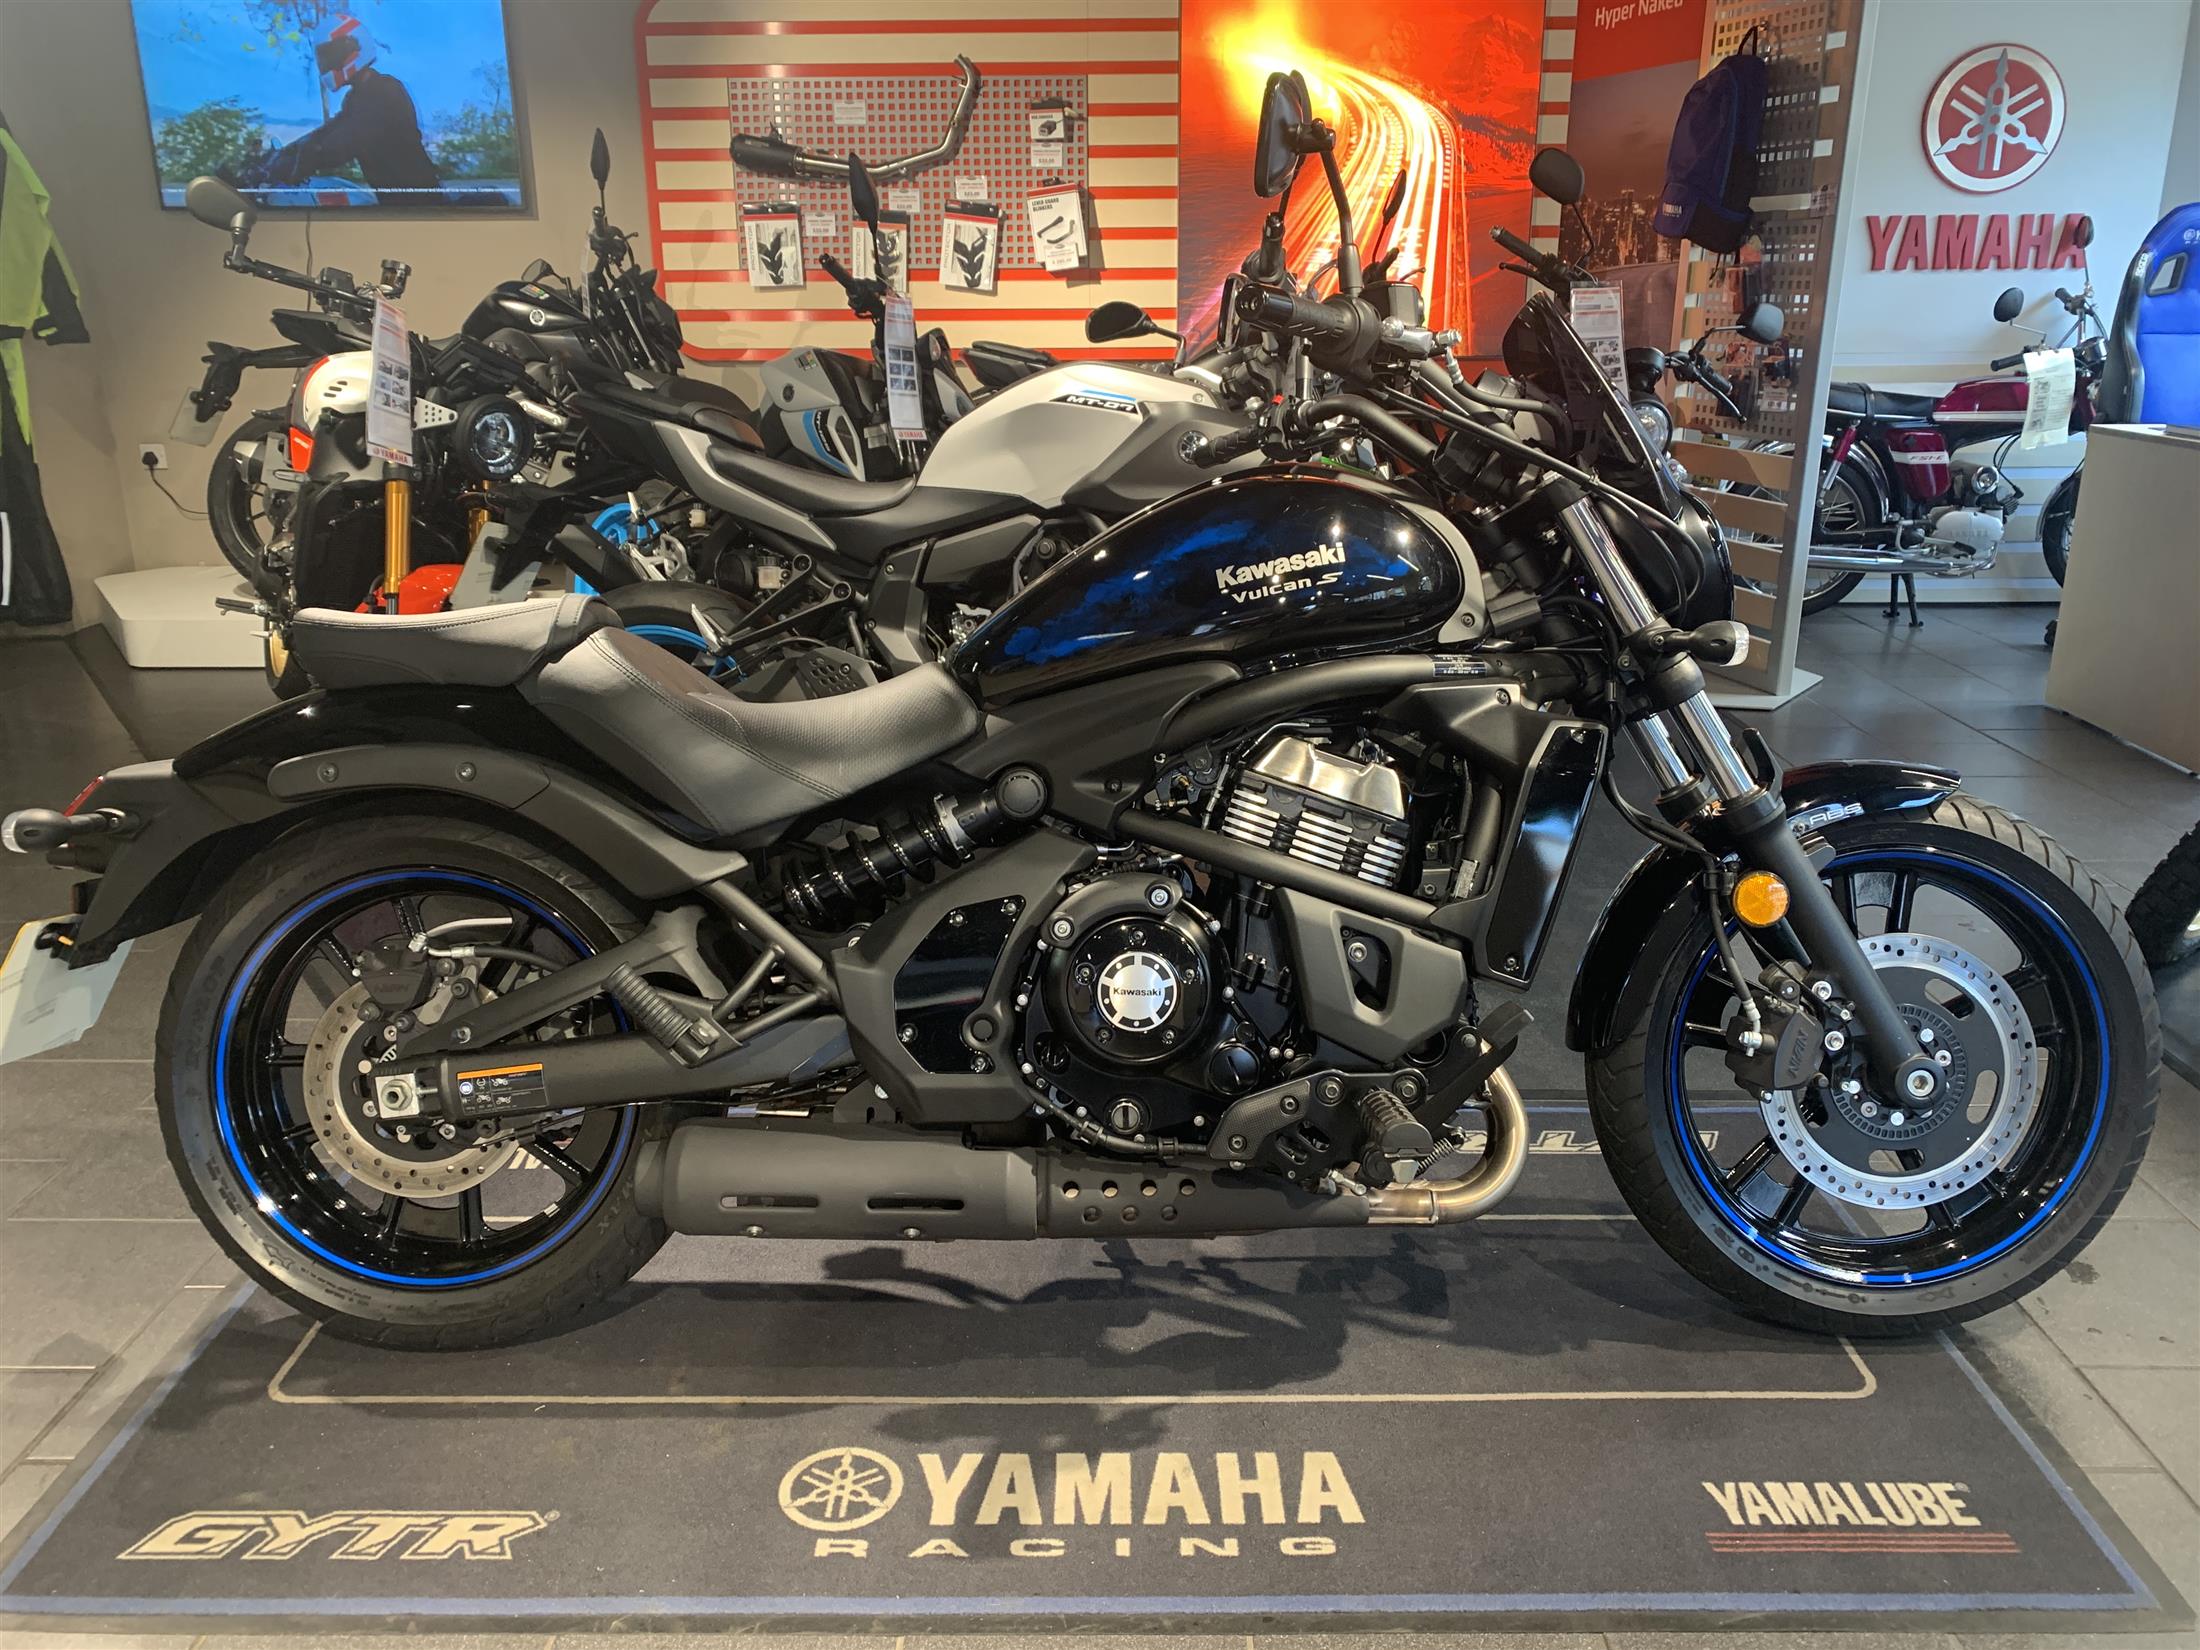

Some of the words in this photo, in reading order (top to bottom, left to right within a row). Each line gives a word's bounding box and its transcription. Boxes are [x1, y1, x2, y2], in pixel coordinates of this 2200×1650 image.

[1595, 3, 1636, 31] Hyper
[1866, 213, 2086, 271] YAMAHA
[1066, 395, 1134, 412] MT-07
[380, 449, 409, 464] YAMAHA
[1215, 541, 1346, 589] Kawasaki
[1231, 578, 1312, 603] Vulcan
[1315, 571, 1344, 586] S
[1809, 802, 1862, 825] ABS
[1113, 987, 1162, 997] Kawasaki
[917, 1451, 1366, 1526] YAMAHA
[1701, 1480, 1982, 1527] YAMALUBE
[116, 1509, 547, 1561] GYTR
[813, 1536, 1337, 1558] RACING
